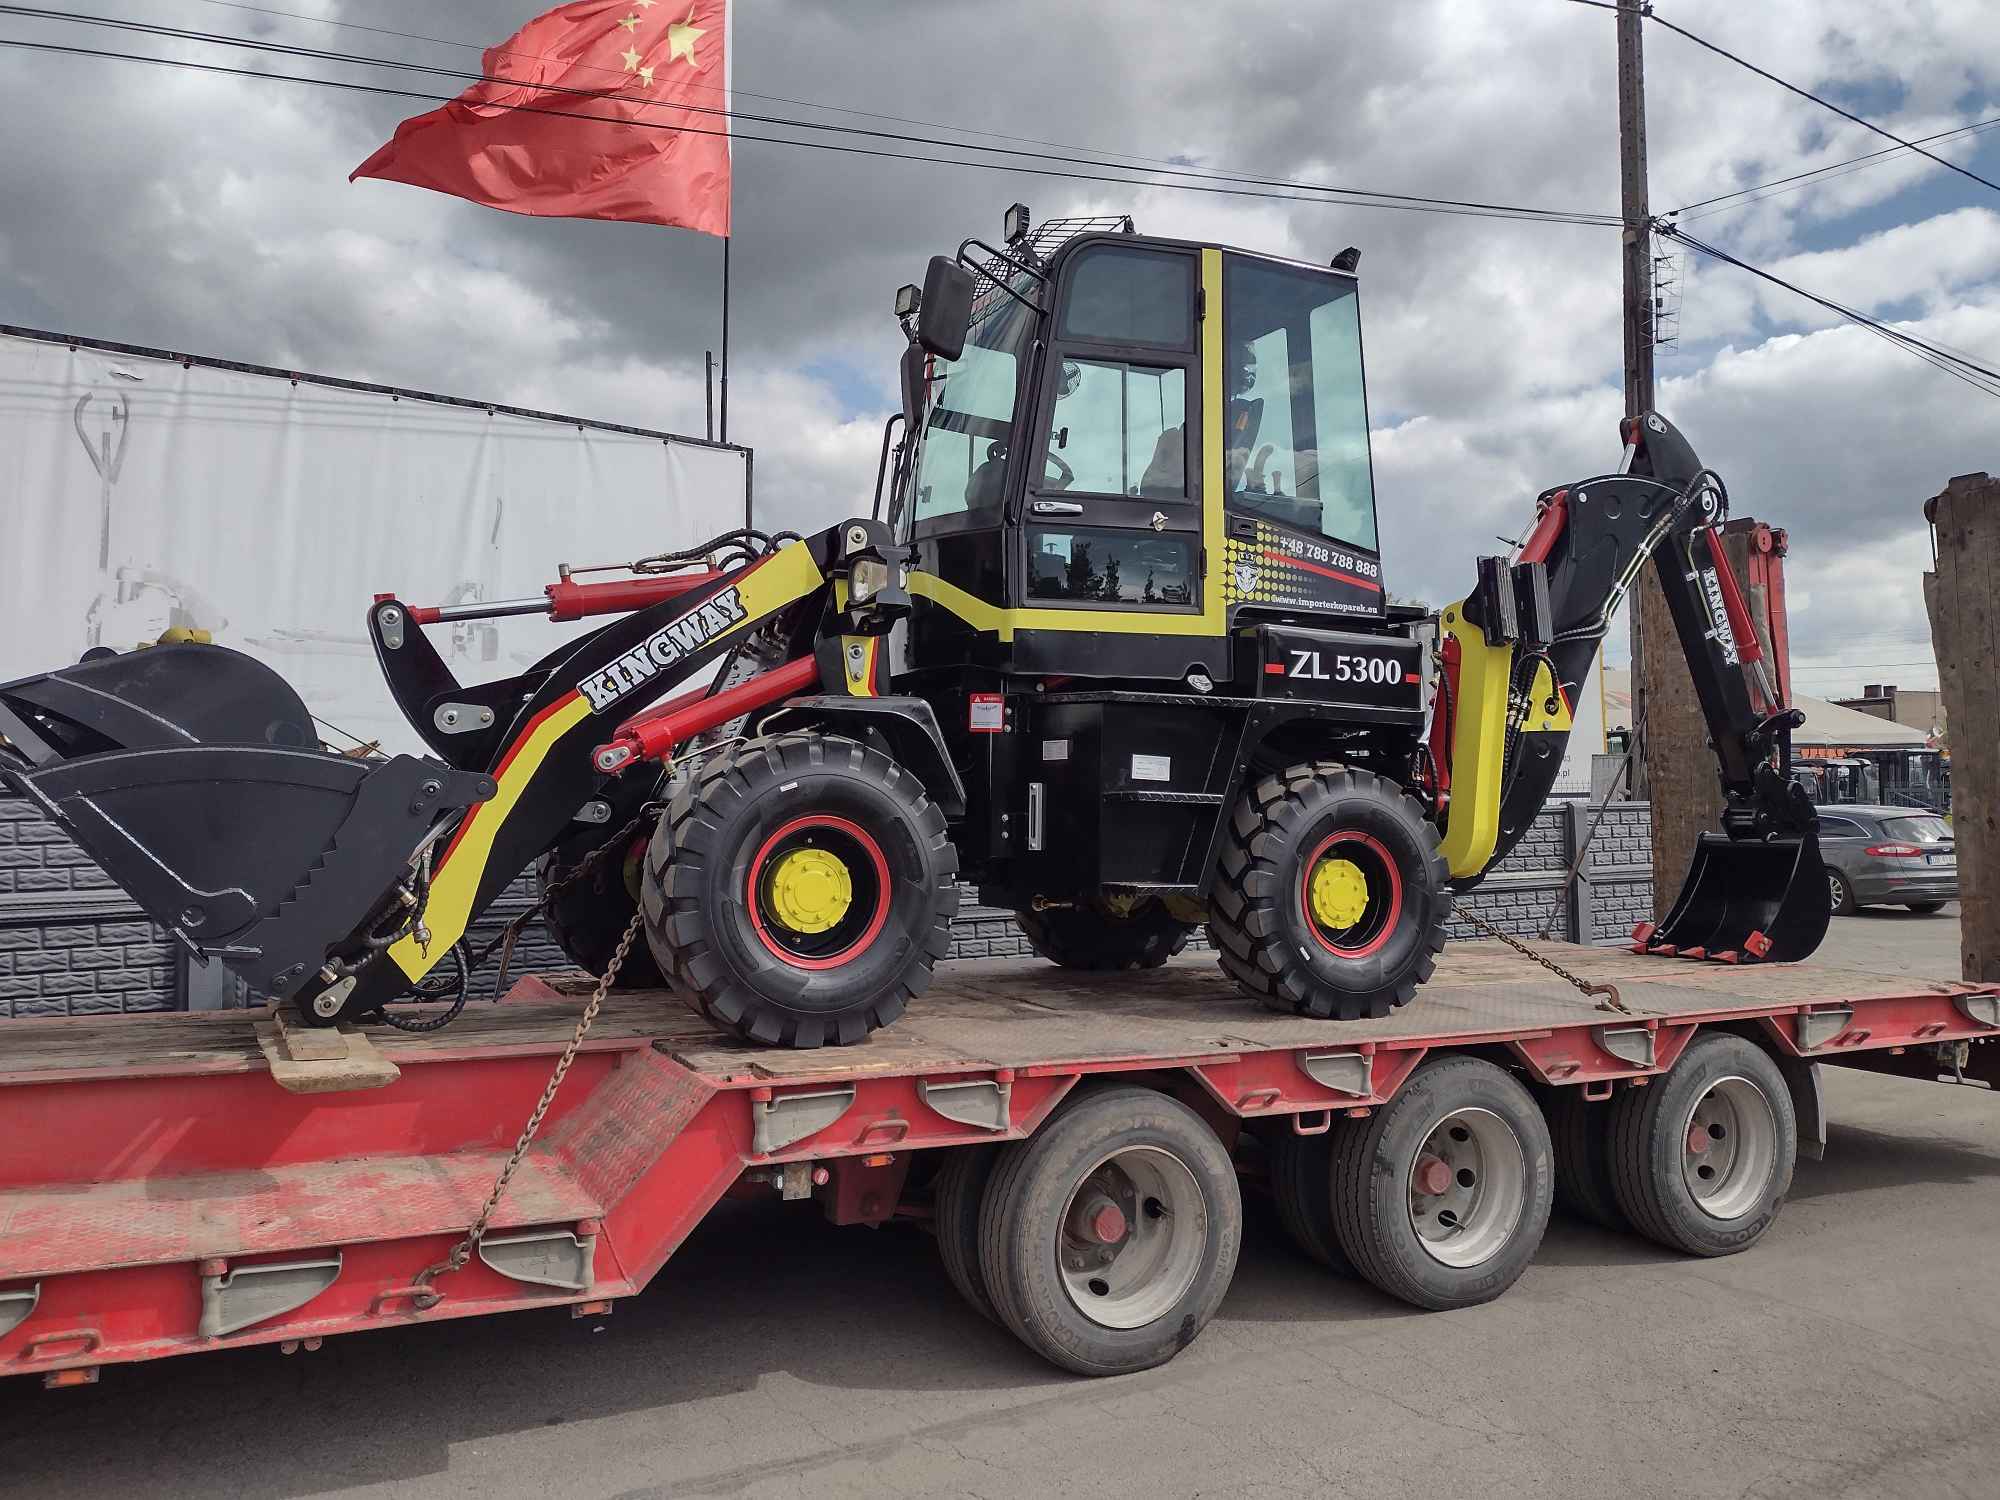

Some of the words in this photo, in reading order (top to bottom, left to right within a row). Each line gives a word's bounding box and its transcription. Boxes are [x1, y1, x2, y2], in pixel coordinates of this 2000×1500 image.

[1280, 536, 1303, 555] +48
[1306, 544, 1329, 562] 788
[1331, 552, 1353, 570] 788
[1355, 560, 1378, 578] 888
[1273, 595, 1378, 614] www.importerkoparek.eu
[580, 586, 745, 710] KINGWAY
[1288, 650, 1330, 680] ZL
[1335, 655, 1402, 685] 5300
